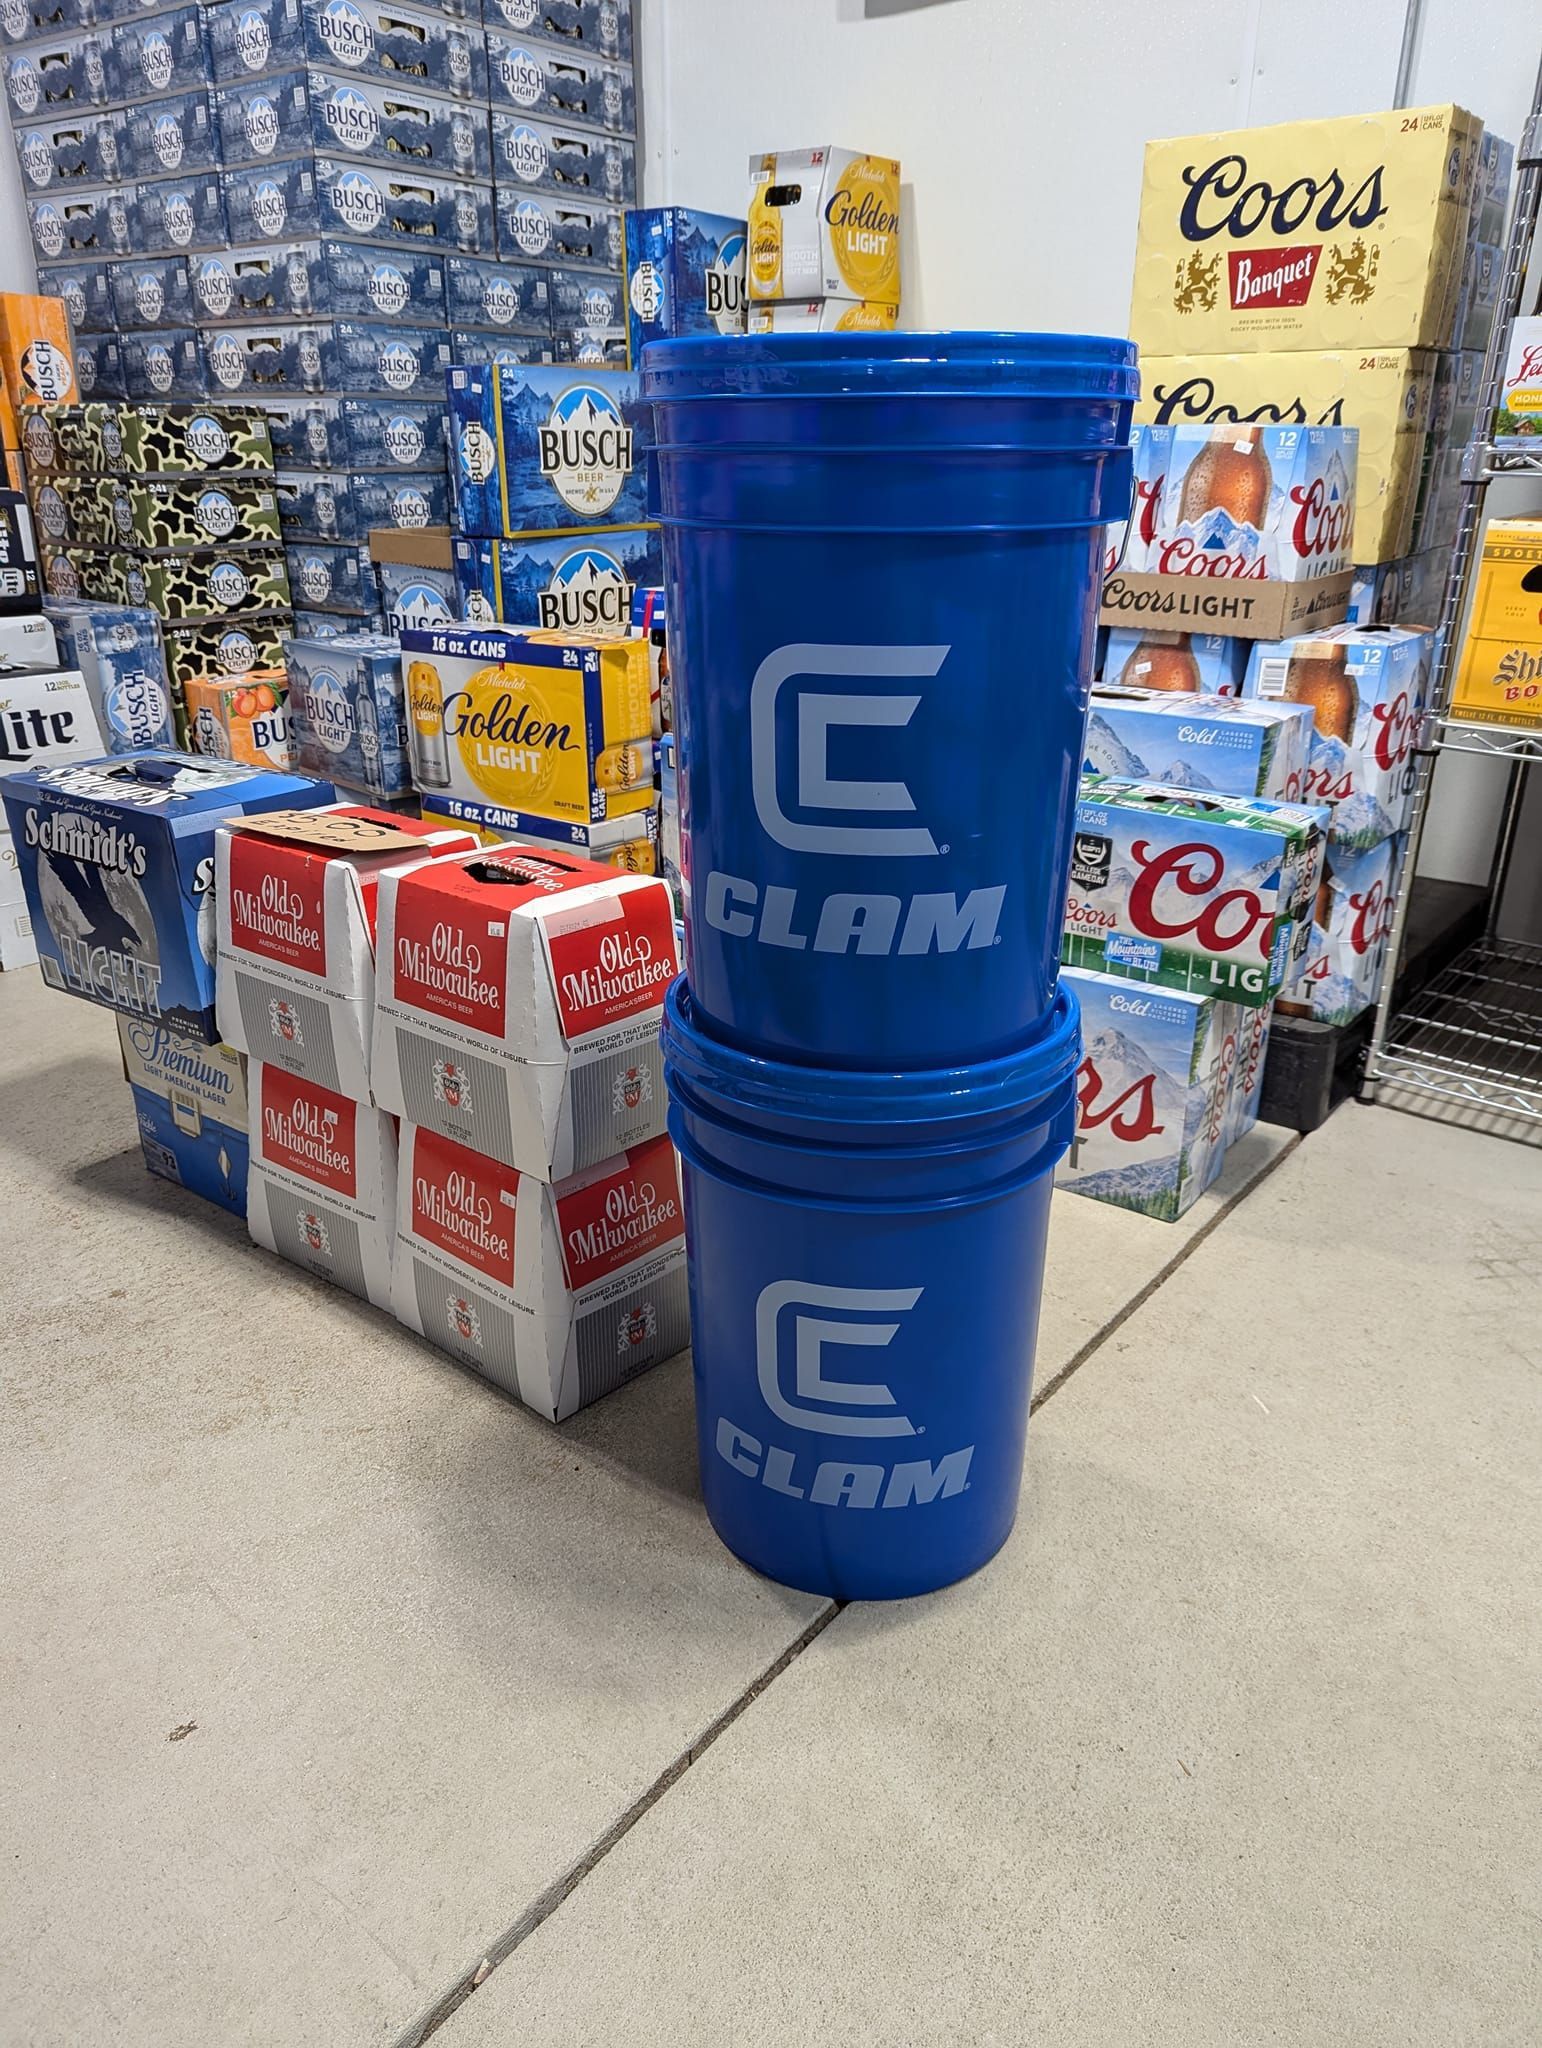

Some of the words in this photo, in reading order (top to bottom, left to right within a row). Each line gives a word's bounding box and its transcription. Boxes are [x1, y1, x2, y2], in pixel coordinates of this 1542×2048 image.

[320, 16, 374, 48] BUSCH
[502, 67, 544, 91] BUSCH
[327, 101, 379, 132] BUSCH
[1400, 117, 1418, 133] 24
[1423, 121, 1443, 131] CANS
[506, 144, 548, 168] BUSCH
[850, 165, 886, 183] Michelob
[333, 189, 386, 215] BUSCH
[1179, 154, 1389, 242] Coors
[825, 190, 900, 234] Golden
[511, 216, 552, 238] BUSCH
[752, 239, 780, 255] Golden
[847, 230, 888, 256] LIGHT
[755, 253, 777, 263] LIGHT
[367, 280, 410, 300] BUSCH
[1235, 252, 1314, 306] Banquet
[482, 291, 520, 310] BUSCH
[640, 262, 653, 321] BUSCH
[847, 311, 881, 327] Michelob
[1251, 323, 1281, 331] MOUNTAIN
[1283, 322, 1303, 331] WATER
[34, 341, 58, 401] BUSCH
[378, 358, 419, 376] BUSCH
[1359, 357, 1376, 370] 24
[187, 433, 230, 449] BUSCH
[384, 431, 425, 449] BUSCH
[541, 428, 631, 472] BUSCH
[1279, 431, 1296, 446] 12
[577, 473, 603, 482] BEER
[196, 506, 238, 523] BUSCH
[391, 502, 431, 519] BUSCH
[1159, 538, 1269, 580] Coors
[2, 571, 18, 594] Lite
[208, 579, 249, 595] BUSCH
[301, 573, 331, 591] BUSCH
[541, 586, 635, 624] BUSCH
[1102, 578, 1177, 613] Coors
[1183, 594, 1255, 620] LIGHT
[433, 636, 446, 650] 16
[449, 641, 467, 654] oz.
[470, 640, 506, 658] CANS
[1206, 636, 1222, 649] 12
[217, 647, 257, 664] BUSCH
[563, 650, 578, 663] 24
[1364, 649, 1380, 663] 12
[477, 670, 525, 690] Michelob
[124, 671, 153, 746] BUSCH
[150, 688, 160, 724] LIGHT
[411, 695, 442, 717] Golden
[628, 655, 642, 739] SMOOTH
[305, 696, 355, 731] BUSCH
[417, 711, 438, 723] LIGHT
[442, 693, 580, 751] Golden
[319, 724, 345, 742] LIGHT
[1178, 725, 1219, 746] Cold
[1219, 736, 1254, 744] FILTERED
[1221, 730, 1254, 738] LAGERED
[1215, 742, 1253, 750] PACKAGED
[476, 744, 540, 773] LIGHT
[619, 744, 630, 791] Golden
[448, 801, 463, 817] 16
[464, 808, 481, 821] oz.
[484, 808, 518, 828] CANS
[554, 800, 570, 809] DRAFT
[572, 803, 585, 811] BEER
[1083, 815, 1108, 826] CANS
[25, 808, 146, 876] Schmidt's
[571, 827, 586, 840] 24
[1081, 845, 1102, 855] ESPN
[1071, 871, 1106, 885] GAMEDAY
[1075, 864, 1102, 873] COLLEGE
[261, 874, 304, 918] Old
[233, 889, 320, 951] Milwaukee
[705, 871, 1007, 955] CLAM
[1065, 898, 1118, 928] Coors
[1070, 923, 1102, 935] LIGHT
[1119, 936, 1132, 945] THE
[432, 921, 481, 973] Old
[600, 930, 652, 973] Old
[1107, 941, 1157, 957] Mountains
[60, 935, 162, 1018] LIGHT
[249, 961, 262, 973] THAT
[262, 966, 294, 983] WONDERFUL
[295, 978, 314, 991] WORLD
[323, 986, 347, 1000] LEISURE
[399, 938, 500, 1009] Milwaukee
[562, 956, 674, 1012] Milwaukee
[1110, 993, 1150, 1017] Cold
[1151, 1008, 1187, 1020] FILTERED
[1155, 1002, 1188, 1014] LAGERED
[171, 1016, 199, 1029] PREMIUM
[1149, 1014, 1187, 1026] PACKAGED
[378, 1003, 399, 1018] BREWED
[412, 1017, 427, 1029] THAT
[428, 1023, 465, 1045] WONDERFUL
[466, 1037, 488, 1053] WORLD
[500, 1050, 528, 1065] LEISURE
[574, 1038, 606, 1054] BREWED
[622, 1025, 642, 1038] THAT
[598, 1040, 624, 1054] WORLD
[626, 1036, 635, 1044] OF
[128, 1022, 234, 1094] Premium
[220, 1052, 238, 1061] TWELVE
[1245, 1003, 1268, 1094] Coors
[144, 1063, 162, 1079] LIGHT
[164, 1072, 200, 1095] AMERICAN
[201, 1088, 226, 1105] LAGER
[1210, 1034, 1235, 1146] Coors
[291, 1098, 335, 1144] Old
[264, 1107, 351, 1175] Milwaukee
[279, 1172, 291, 1186] THAT
[291, 1178, 323, 1199] WONDERFUL
[324, 1193, 343, 1208] WORLD
[352, 1206, 376, 1222] LEISURE
[447, 1171, 492, 1225] Old
[605, 1181, 655, 1223] Old
[416, 1178, 509, 1260] Milwaukee
[569, 1198, 677, 1264] Milwaukee
[428, 1251, 442, 1263] THAT
[443, 1260, 476, 1287] WONDERFUL
[477, 1279, 498, 1298] WORLD
[508, 1296, 535, 1315] LEISURE
[602, 1285, 628, 1301] WORLD
[640, 1265, 666, 1282] LEISURE
[716, 1417, 974, 1508] CLAM
